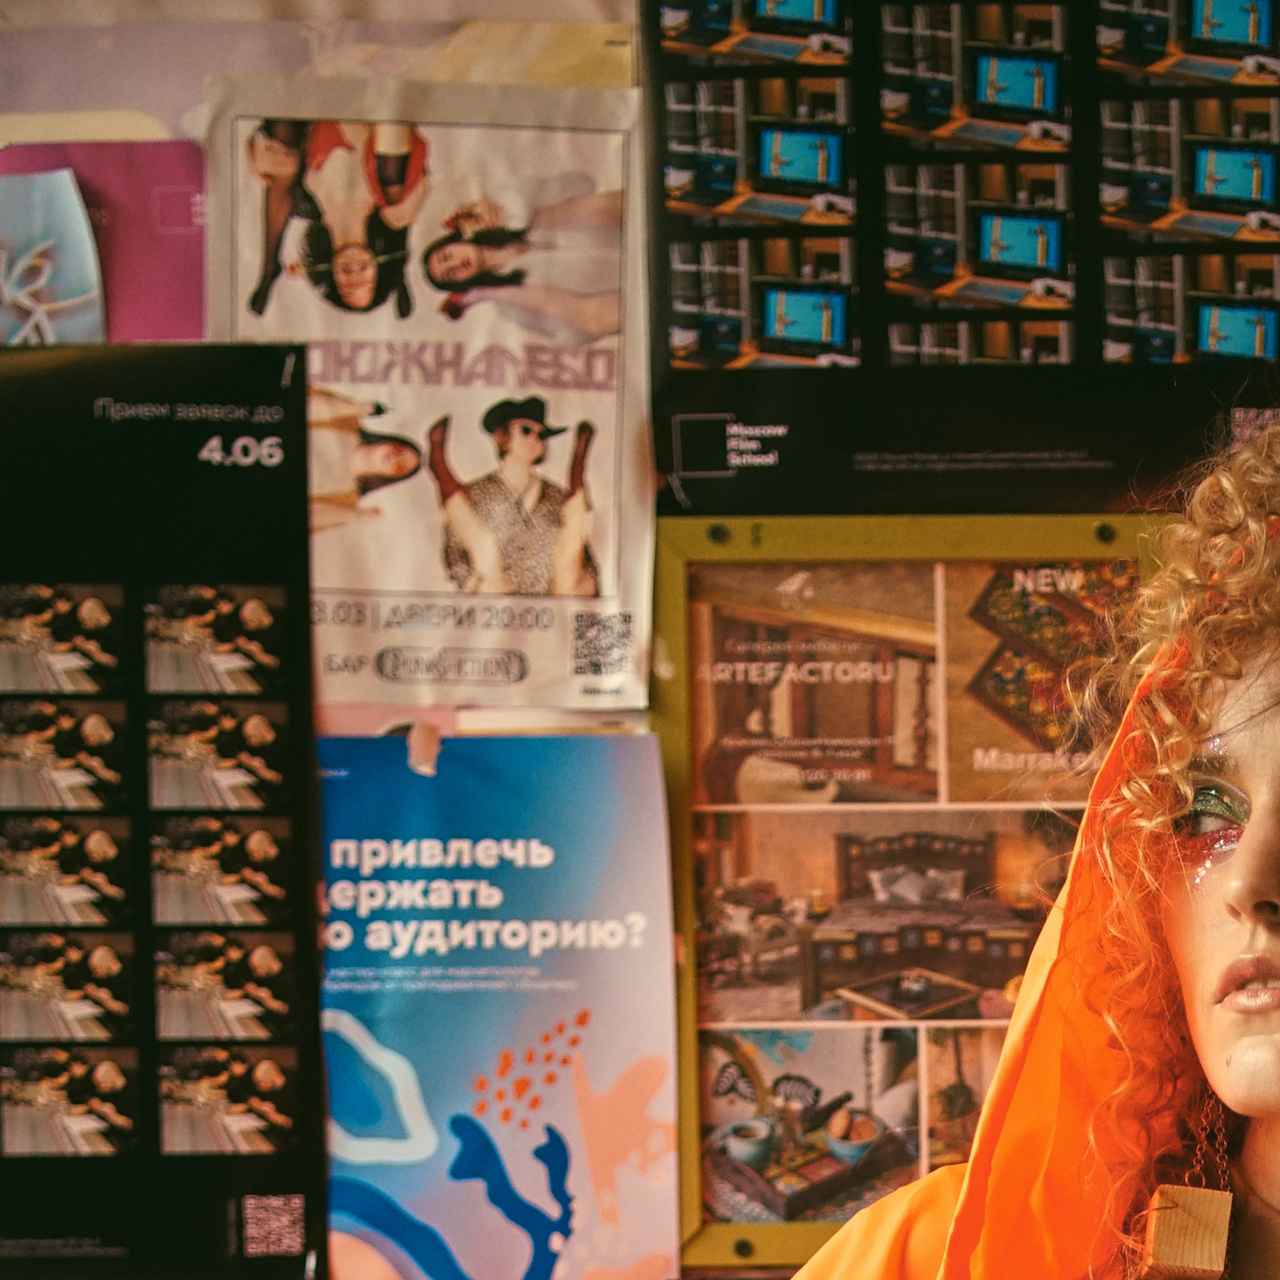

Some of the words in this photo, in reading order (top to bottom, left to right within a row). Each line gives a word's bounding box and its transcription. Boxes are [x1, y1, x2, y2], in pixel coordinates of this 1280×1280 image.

[94, 398, 168, 425] Прием
[172, 401, 247, 423] заявок
[250, 402, 284, 425] до
[197, 435, 284, 467] 4.06
[1012, 568, 1084, 594] NEW
[331, 839, 555, 877] привлечь
[365, 913, 648, 957] аудиторию?
